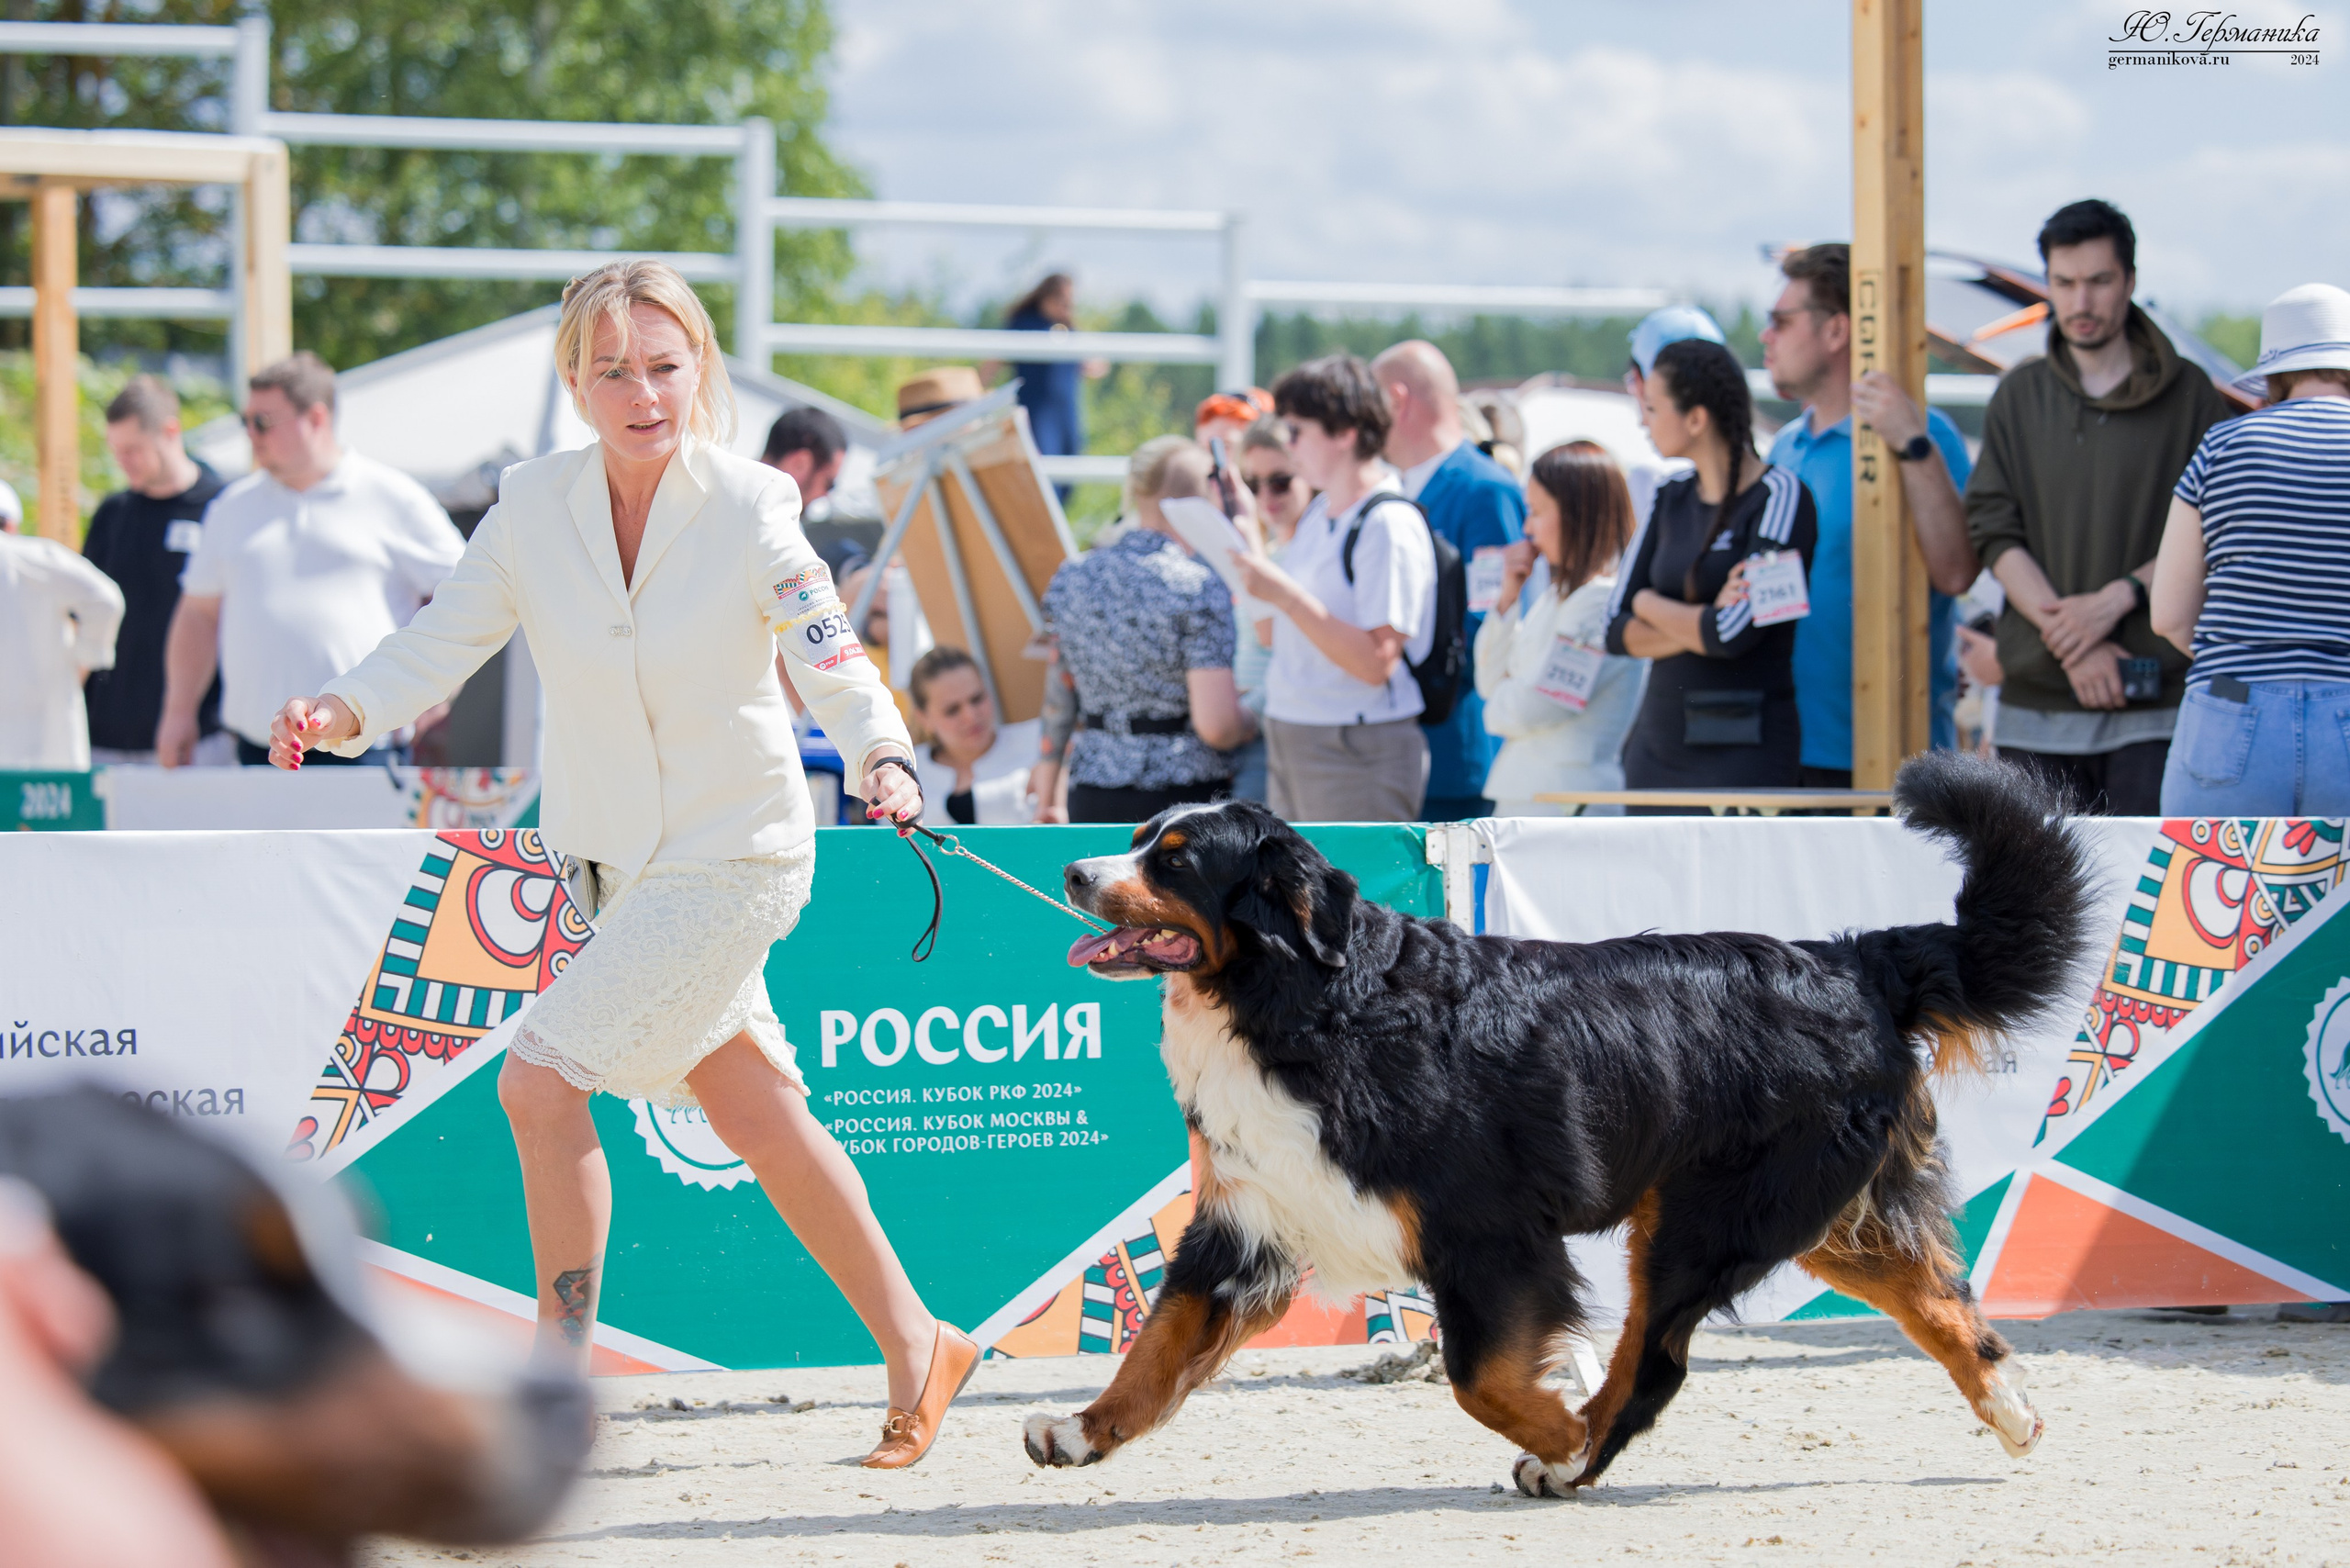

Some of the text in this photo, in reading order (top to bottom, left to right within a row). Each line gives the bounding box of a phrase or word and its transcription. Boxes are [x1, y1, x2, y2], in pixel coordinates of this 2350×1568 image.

[0, 1020, 137, 1058] йская
[820, 1002, 1102, 1069] РОССИЯ
[823, 1082, 1082, 1106] «РОССИЯ. КУБОК РКФ 2024»
[825, 1109, 1089, 1134] «РОССИЯ. КУБОК МОСКВЫ &
[836, 1130, 1110, 1155] УБОК ГОРОДОВ-ГЕРОЕВ 2024»
